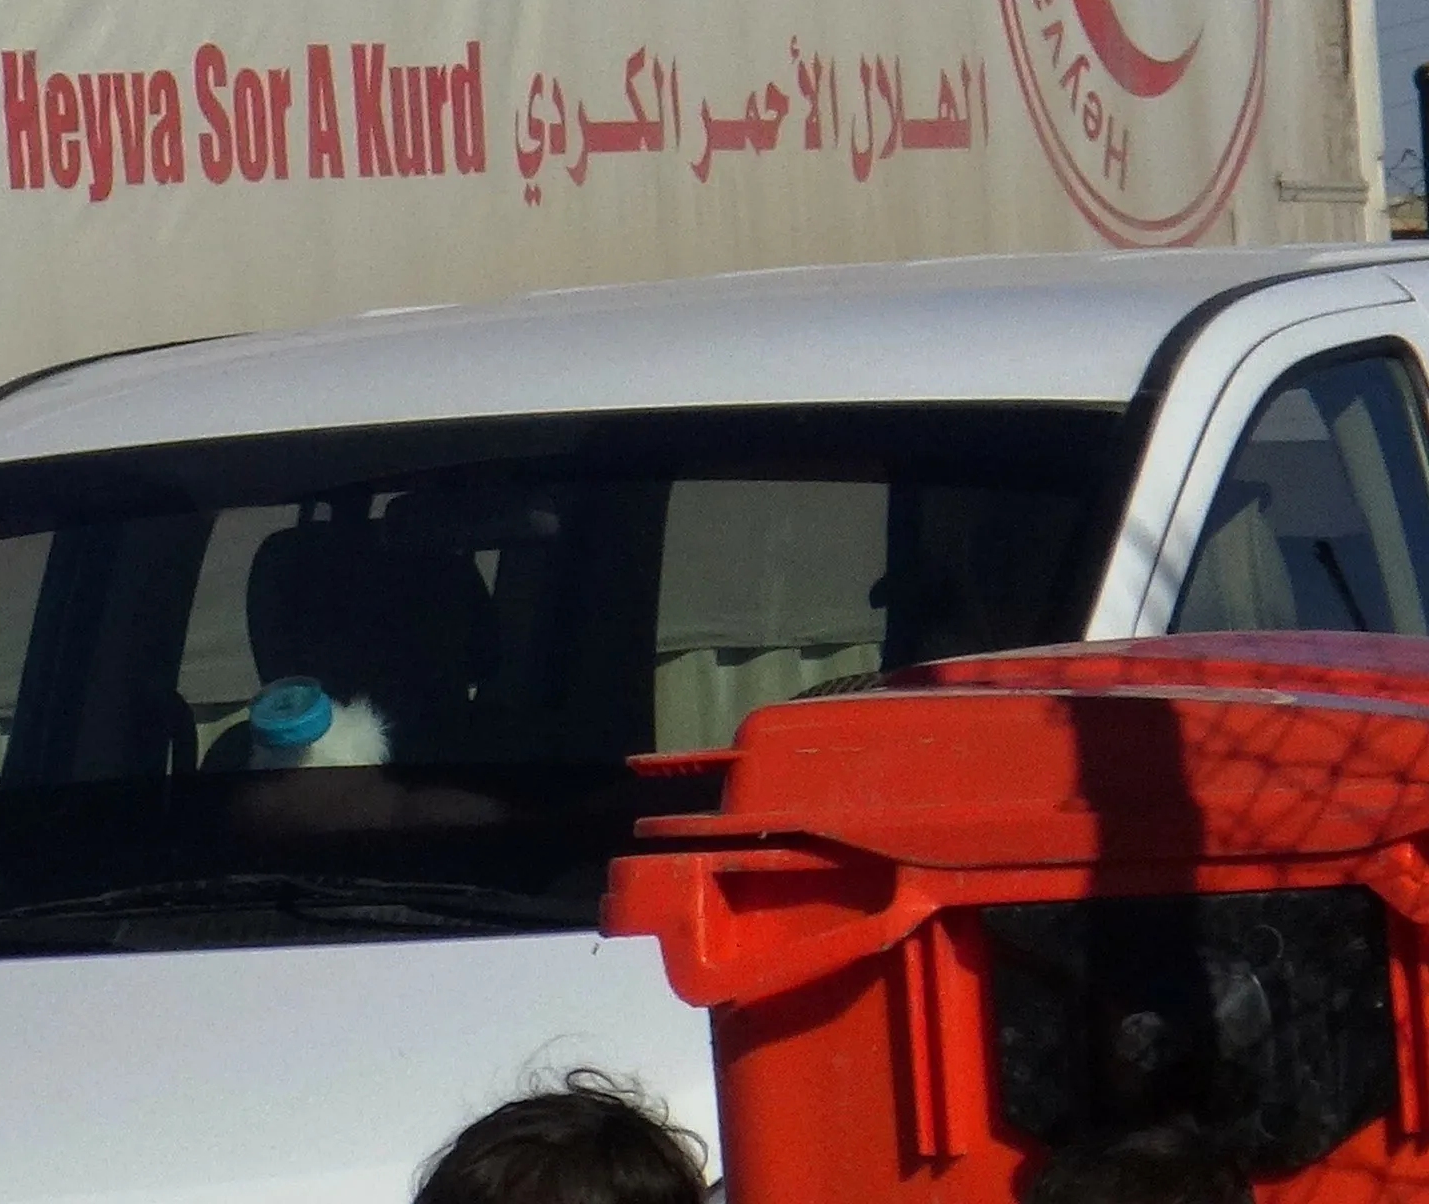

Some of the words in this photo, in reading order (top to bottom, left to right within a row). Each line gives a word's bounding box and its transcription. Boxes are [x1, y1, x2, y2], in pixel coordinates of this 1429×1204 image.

[0, 48, 185, 203] Heyva
[194, 43, 293, 185] Sor
[306, 44, 345, 180] A
[350, 40, 487, 177] Kurd
[515, 44, 680, 208] الكردي
[690, 34, 839, 185] الأحمر
[850, 53, 990, 184] الهلال
